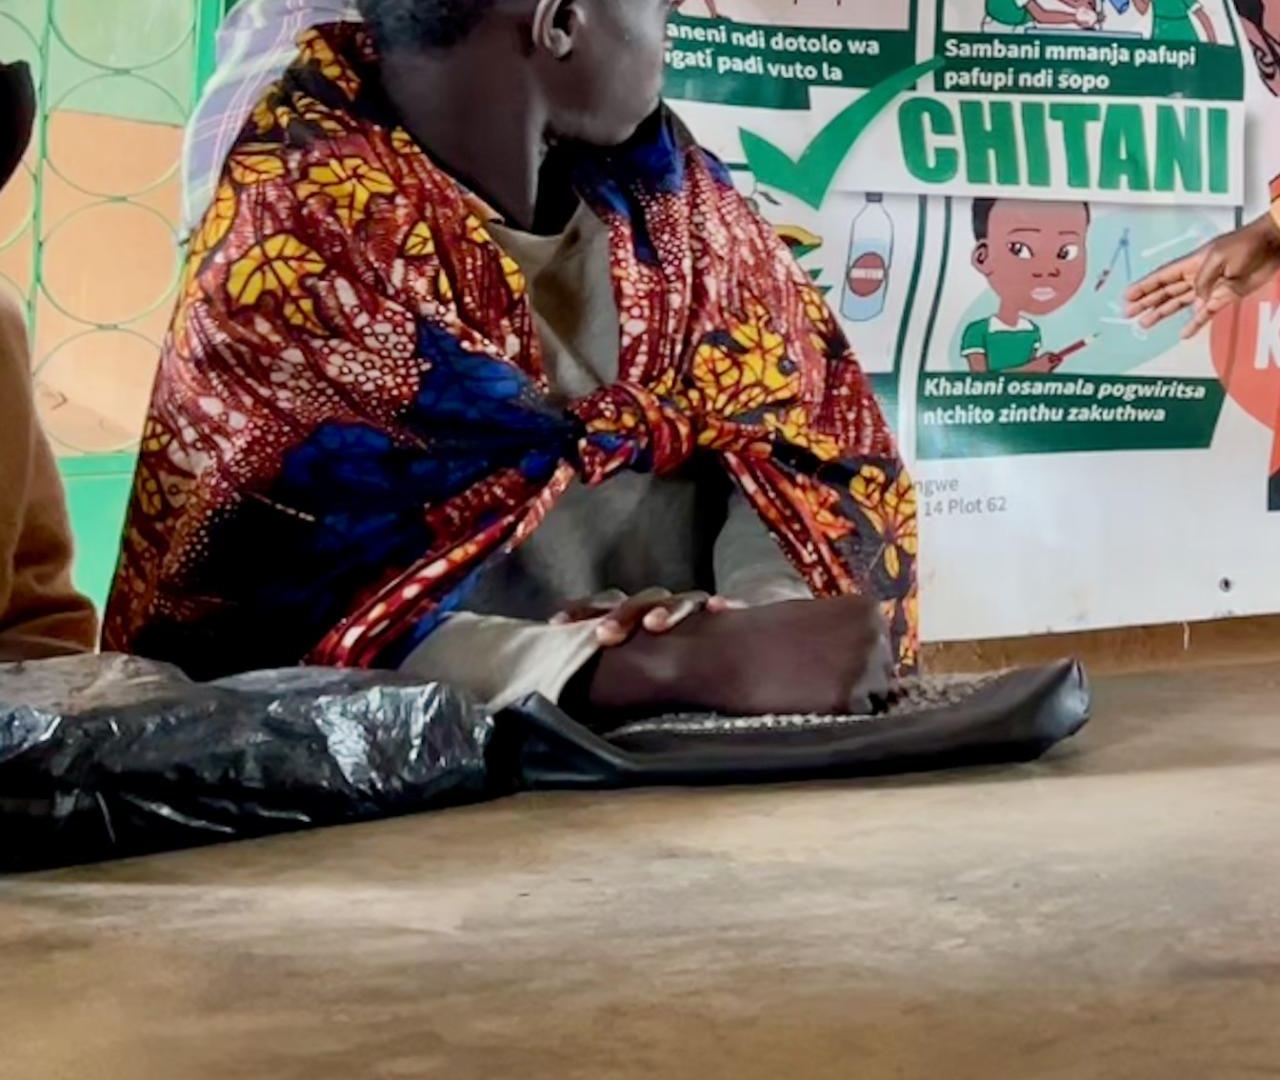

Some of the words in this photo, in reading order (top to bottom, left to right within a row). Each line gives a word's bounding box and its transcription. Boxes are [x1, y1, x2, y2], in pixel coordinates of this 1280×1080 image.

[666, 22, 727, 43] aneni
[731, 30, 765, 49] ndi
[770, 33, 842, 55] dotolo
[847, 39, 880, 55] wa
[944, 38, 1040, 59] Sambani
[1045, 44, 1130, 66] mmanja
[1134, 45, 1196, 69] pafupi
[717, 56, 764, 74] padi
[768, 62, 817, 80] vuto
[822, 63, 843, 81] la
[944, 68, 1013, 90] pafupi
[1018, 69, 1053, 88] ndi
[1057, 72, 1110, 92] sopo
[900, 96, 1229, 194] CHITANI
[924, 377, 1004, 397] Khalani
[1007, 378, 1095, 397] osamala
[1097, 380, 1206, 401] pogwiritsa
[923, 405, 994, 425] ntchito
[997, 403, 1064, 423] zinthu
[1067, 404, 1166, 422] zakuthwa
[925, 500, 943, 517] 14
[948, 498, 982, 515] Plot
[986, 496, 1007, 512] 62
